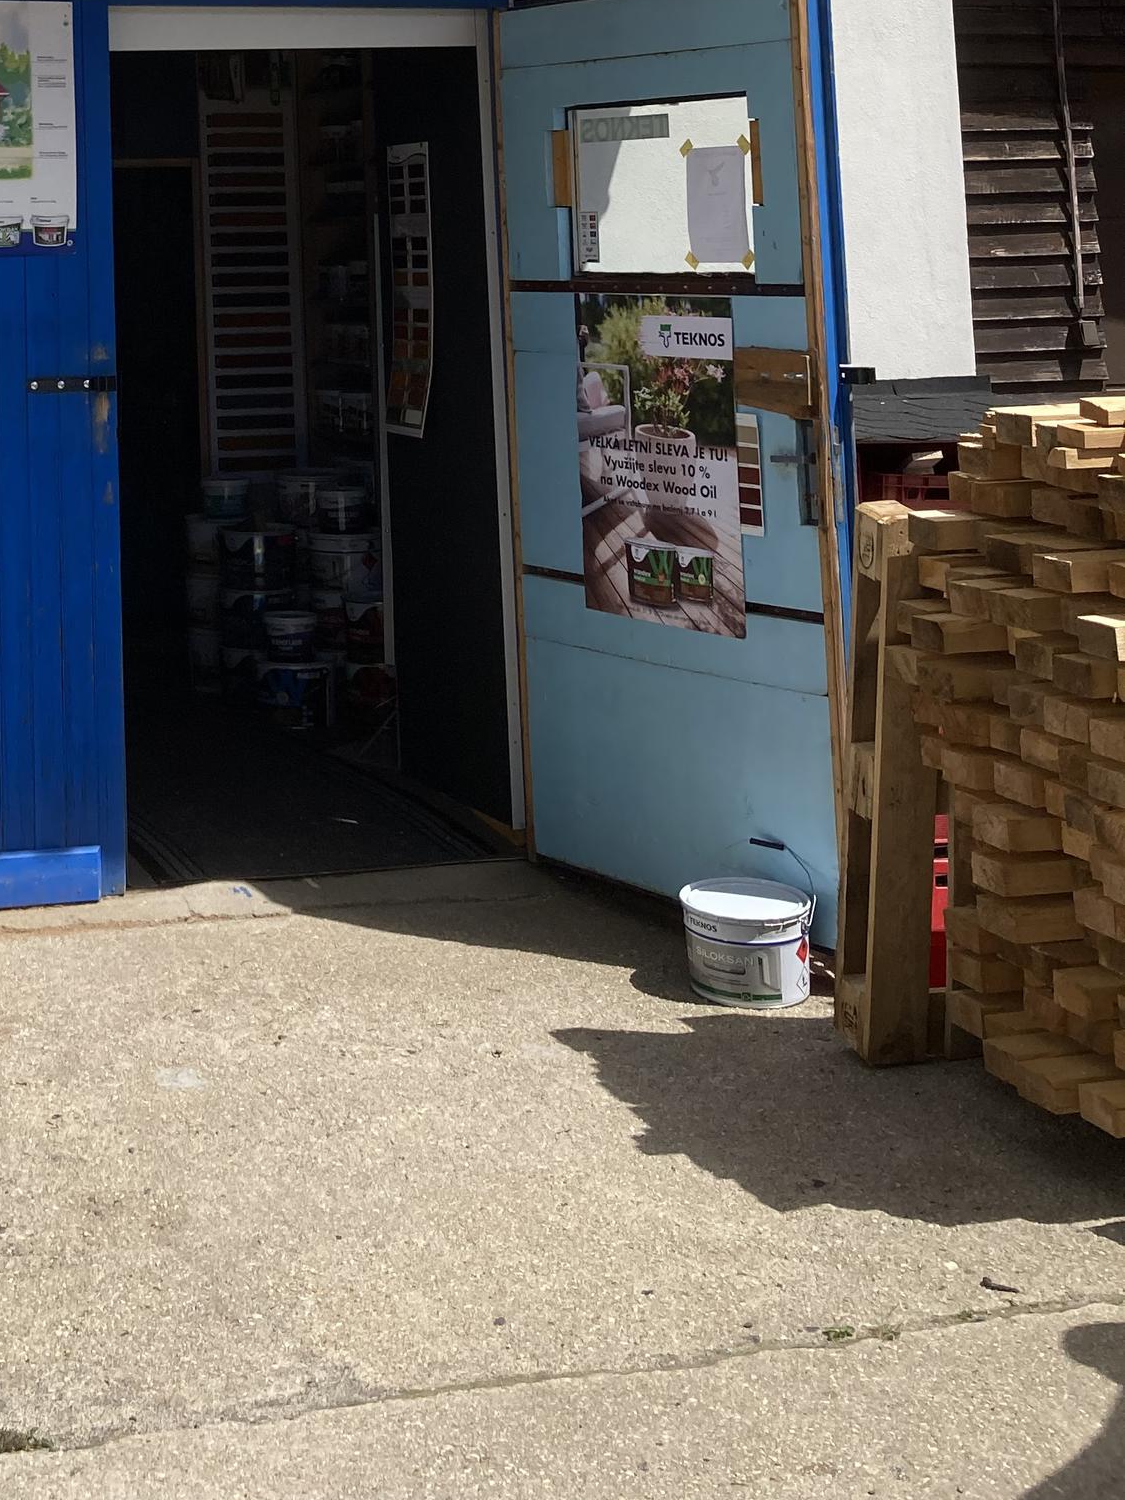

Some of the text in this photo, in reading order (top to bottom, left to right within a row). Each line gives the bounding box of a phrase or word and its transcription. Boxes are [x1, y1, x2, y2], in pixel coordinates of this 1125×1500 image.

[674, 331, 725, 348] TEKNOS
[588, 434, 729, 462] VELKÁ LETNÍ SLEVA JE TU!
[603, 454, 711, 479] Využijte slevu 10 %
[600, 474, 717, 499] na Woodex Wood Oil
[688, 915, 718, 933] TEKNOS
[695, 945, 755, 967] SILOKSAN
